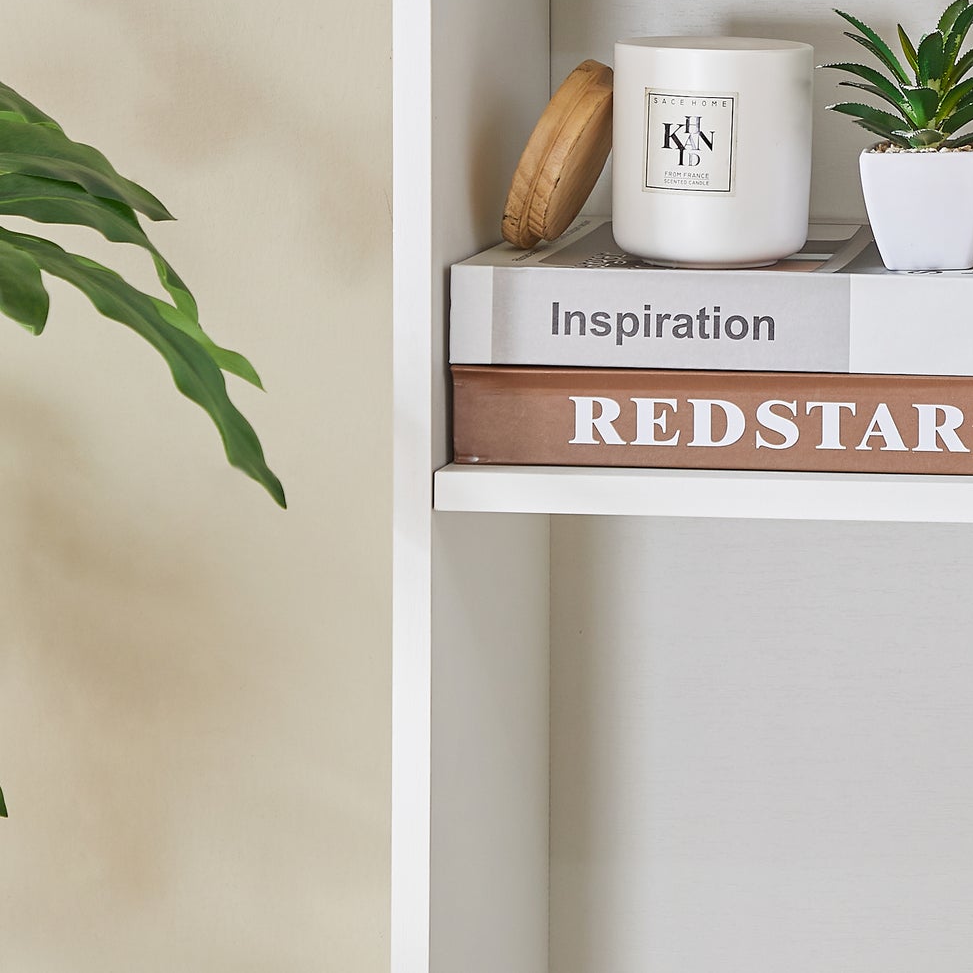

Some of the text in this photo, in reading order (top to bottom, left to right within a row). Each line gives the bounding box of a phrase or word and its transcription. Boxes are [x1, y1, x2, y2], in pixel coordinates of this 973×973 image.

[653, 97, 684, 106] SACE
[551, 301, 776, 346] Inspiration
[568, 395, 971, 453] REDSTAR
